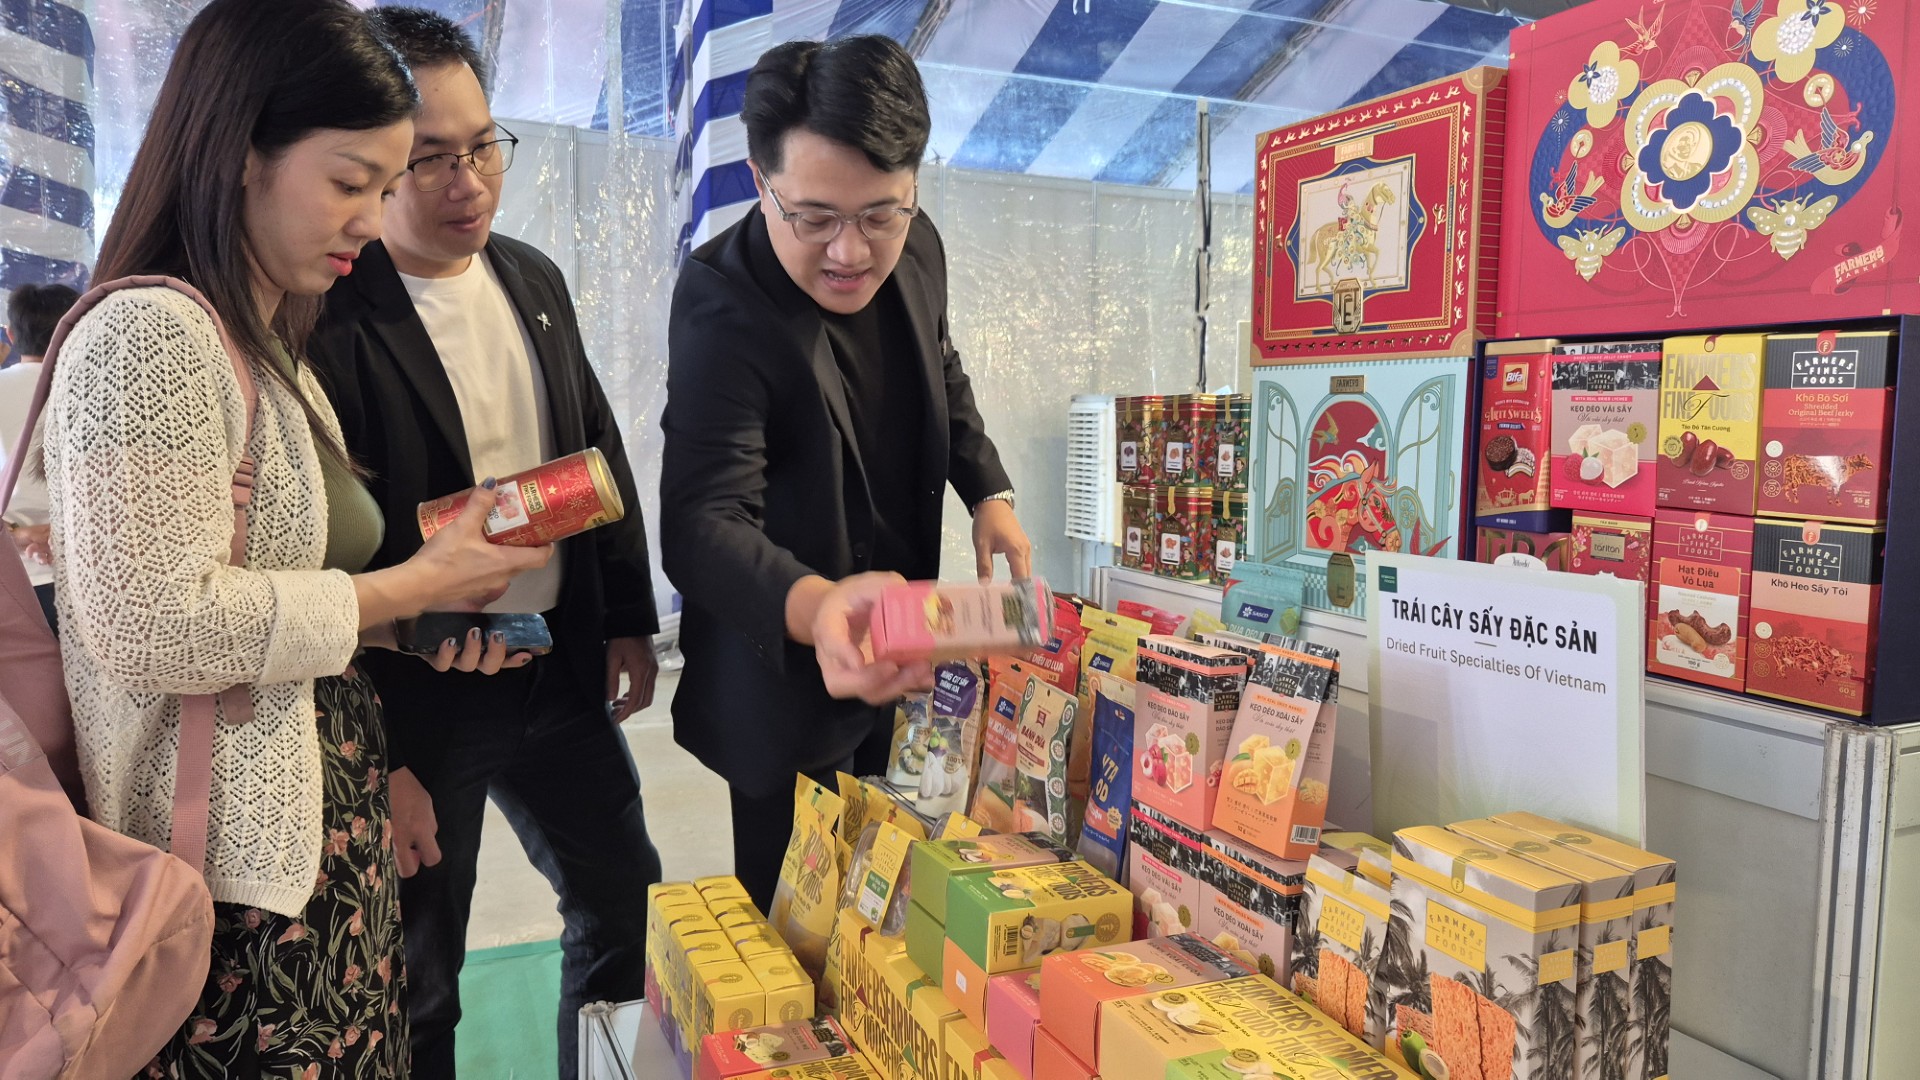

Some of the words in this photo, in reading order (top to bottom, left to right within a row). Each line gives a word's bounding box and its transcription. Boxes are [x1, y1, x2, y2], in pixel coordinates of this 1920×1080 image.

[1834, 245, 1884, 278] FARMERS
[1836, 257, 1885, 285] MARKET
[1664, 352, 1757, 391] FARMERS
[1796, 356, 1854, 371] FARMERS
[1809, 367, 1838, 375] FINE
[1506, 371, 1523, 383] Bifa
[1802, 376, 1844, 385] FOODS
[1795, 393, 1815, 402] Khô
[1832, 393, 1849, 403] Sợi
[1788, 408, 1817, 417] Original
[1834, 409, 1854, 418] Jerky
[528, 482, 543, 511] FARMERS
[1594, 543, 1620, 554] tarlton
[1681, 533, 1720, 547] FARMERS
[1685, 547, 1713, 556] FOODS
[1782, 547, 1838, 564] FARMERS
[1795, 556, 1822, 567] FINE
[1789, 565, 1828, 576] FOODS
[1771, 578, 1788, 588] Khô
[1790, 582, 1809, 591] Heo
[1811, 583, 1829, 596] Sấy
[1832, 586, 1848, 596] Tỏi
[1391, 597, 1426, 624] TRÁI
[1431, 602, 1464, 630] CÂY
[1469, 606, 1503, 638] SẤY
[1510, 615, 1548, 648] ĐẶC
[1555, 621, 1597, 654] SẢN
[1386, 637, 1416, 655] Dried
[1420, 643, 1447, 661] Fruit
[1450, 650, 1521, 677] Specialties
[1524, 665, 1541, 681] Of
[1544, 667, 1606, 695] Vietnam
[1049, 862, 1117, 897] FARMERS
[1429, 914, 1483, 946] FARMERS
[1441, 925, 1468, 946] FINE
[1435, 934, 1473, 960] FOODS
[1228, 976, 1323, 1032] FARMERS
